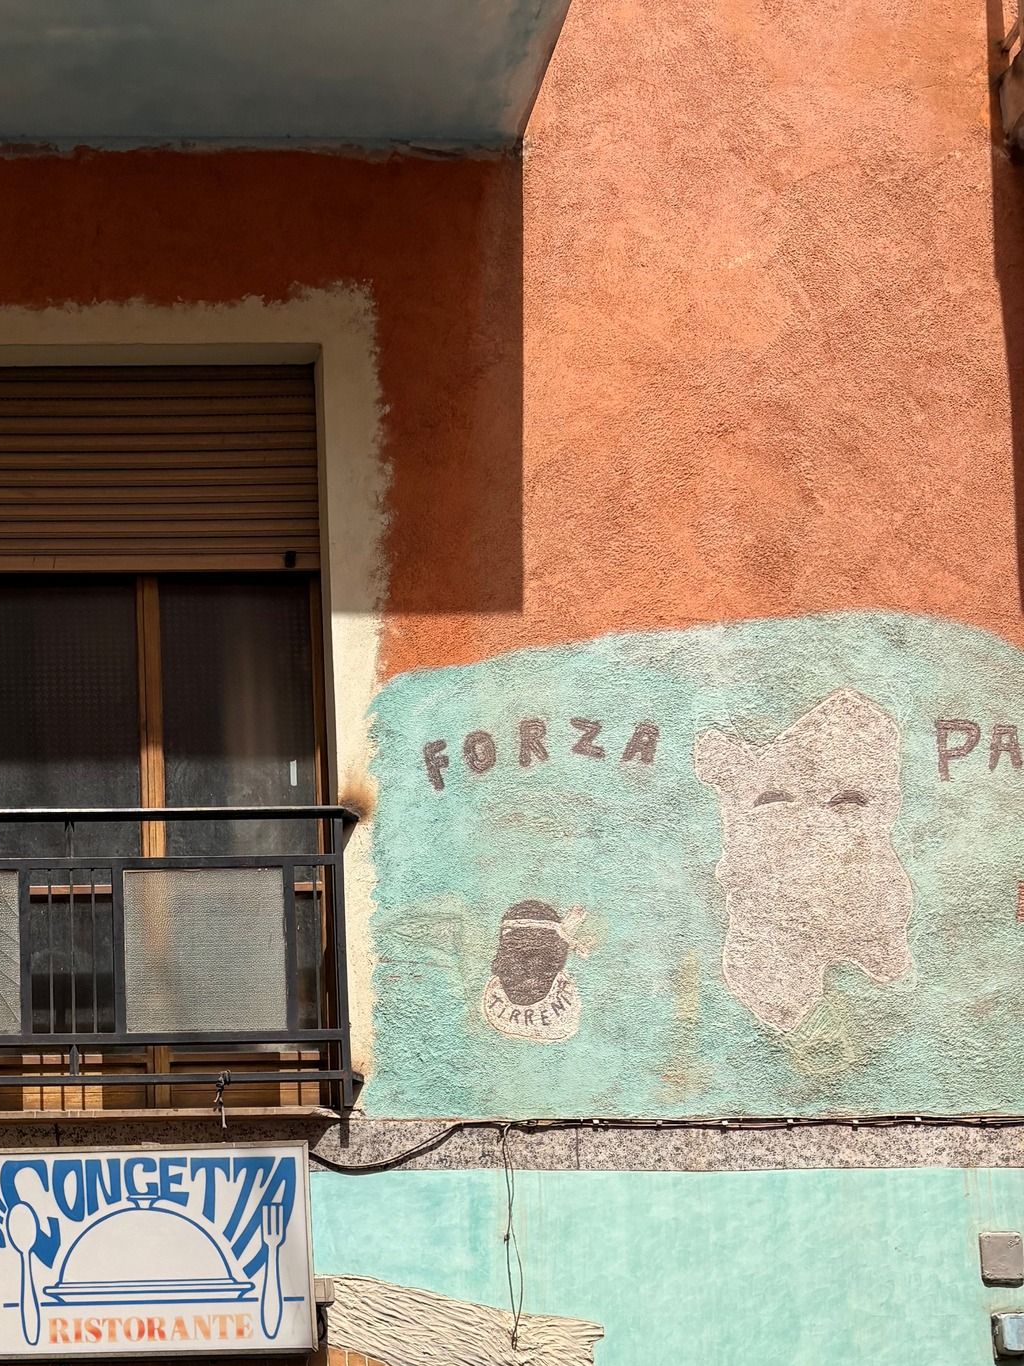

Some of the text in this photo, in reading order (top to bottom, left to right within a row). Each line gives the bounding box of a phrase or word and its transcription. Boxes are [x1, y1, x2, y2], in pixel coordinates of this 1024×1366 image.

[423, 717, 660, 791] FORZA
[0, 1156, 296, 1280] CONCETTA
[47, 1312, 255, 1345] RISTORANTE
